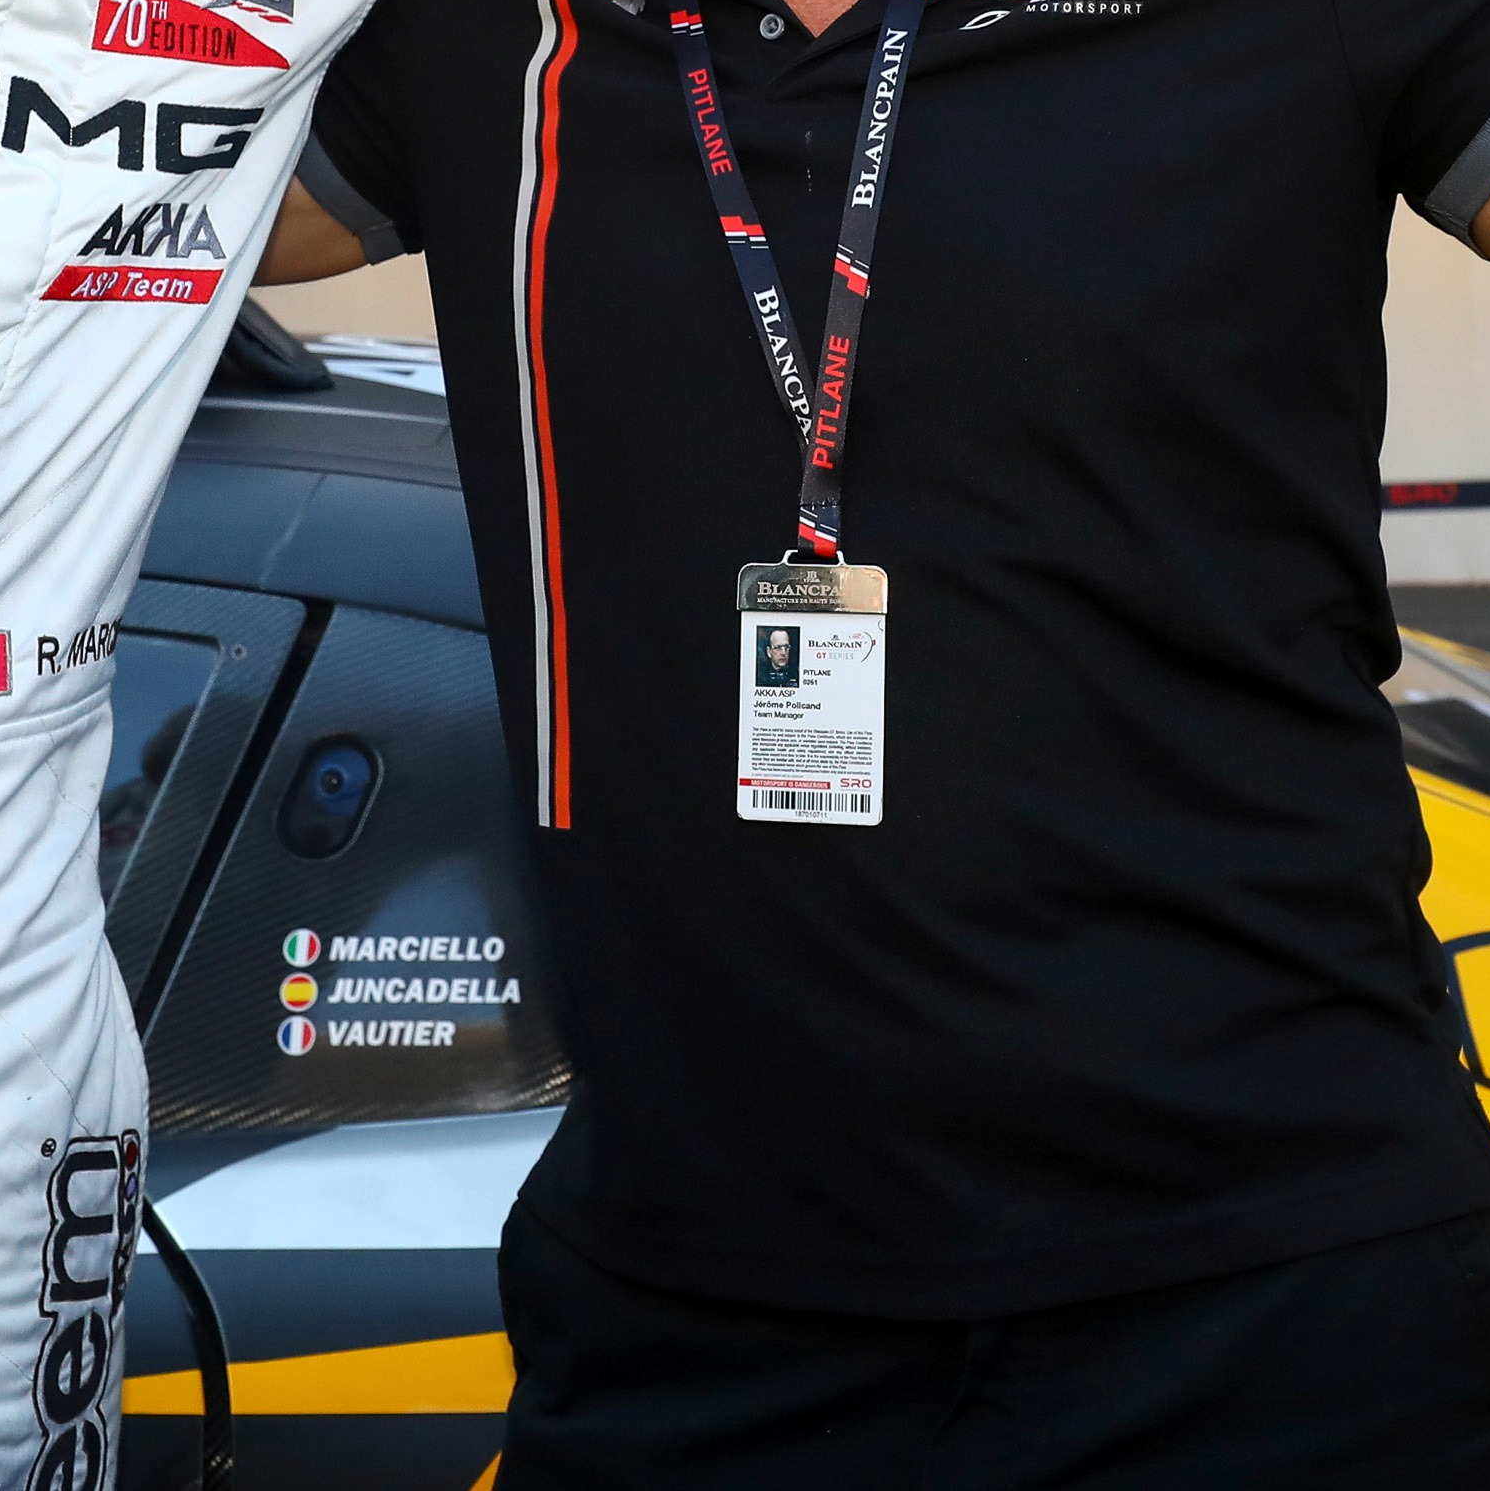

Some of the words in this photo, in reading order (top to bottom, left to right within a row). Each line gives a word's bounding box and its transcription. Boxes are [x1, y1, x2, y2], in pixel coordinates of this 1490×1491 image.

[1025, 3, 1143, 15] MOTORSPORT
[149, 20, 238, 61] EDITION
[687, 67, 735, 177] PITLANE
[851, 27, 908, 209] BLANCPAIN
[75, 202, 228, 260] AKKA
[70, 271, 120, 298] ASP
[121, 271, 195, 300] Team
[752, 285, 813, 445] BLANCPA
[811, 334, 852, 470] PITLANE
[757, 581, 841, 596] BLANCPA
[37, 634, 61, 676] R.
[808, 639, 863, 649] BLANCPAIN
[802, 669, 832, 677] PITLANE
[753, 689, 777, 698] AKKA
[778, 689, 796, 698] ASP
[785, 701, 822, 711] Policand
[753, 710, 773, 718] Team
[774, 711, 804, 721] Manager
[750, 779, 788, 788] MOTORSPORT
[839, 778, 872, 789] SRO
[328, 936, 506, 962] MARCIELLO
[327, 977, 522, 1004] JUNCADELLA
[327, 1019, 458, 1047] VAUTIER
